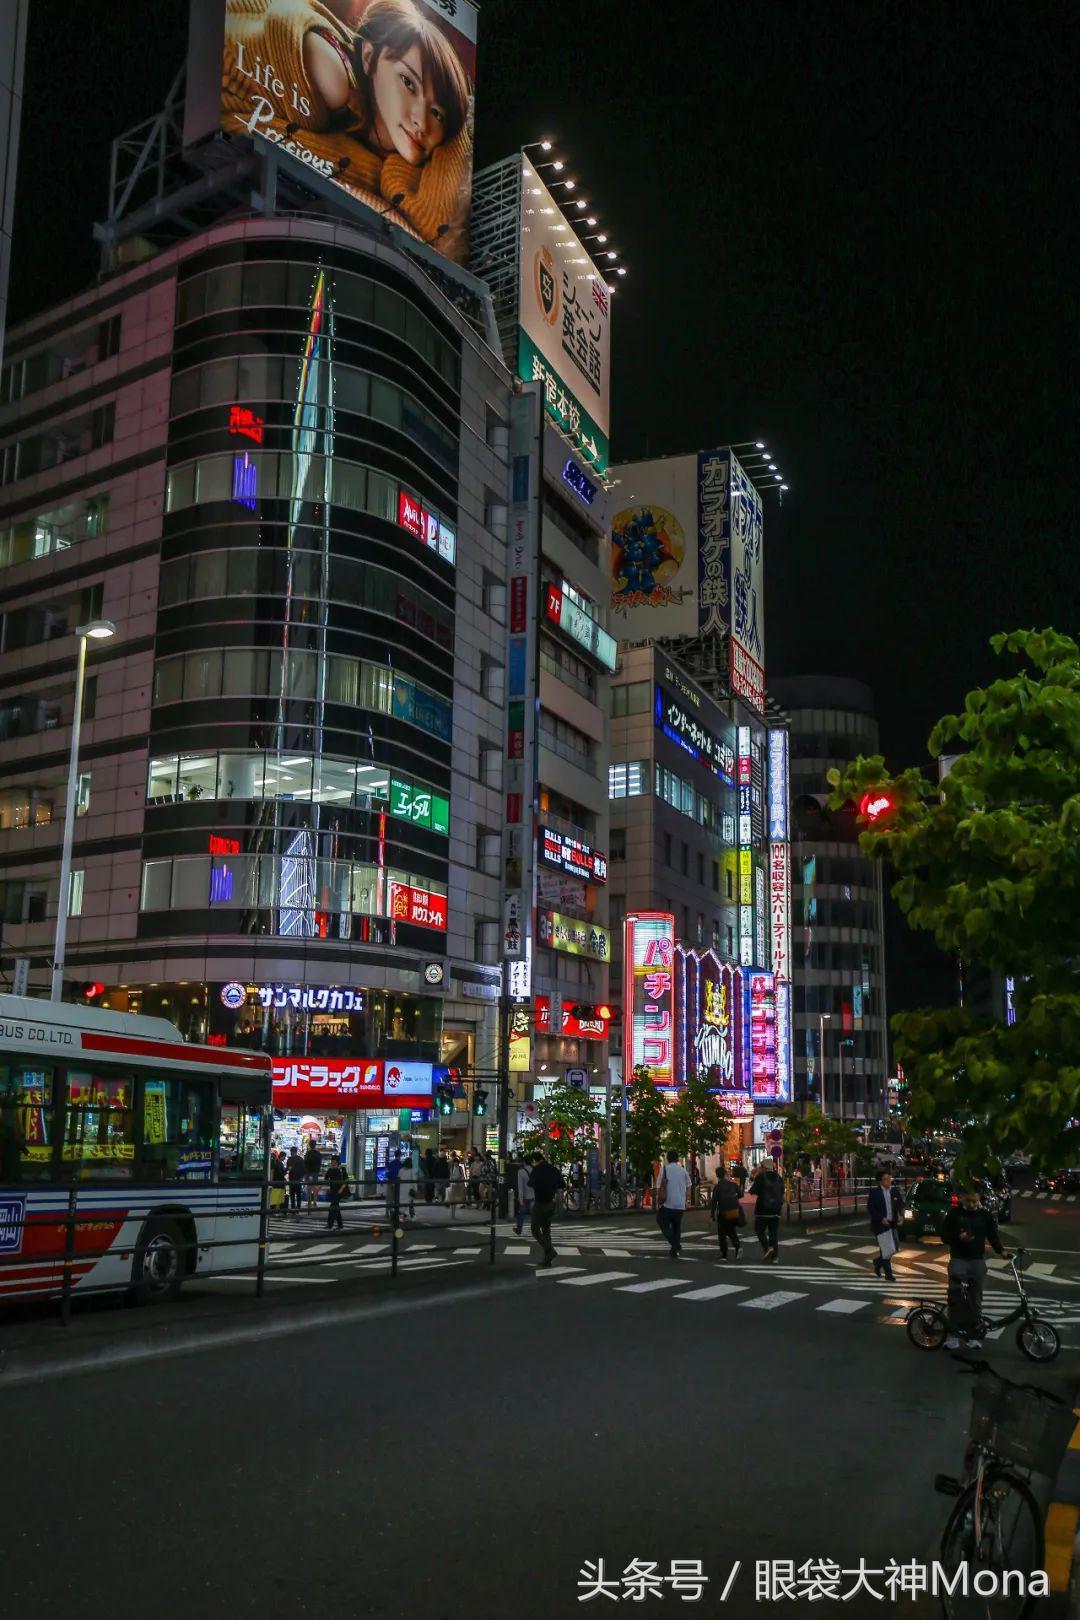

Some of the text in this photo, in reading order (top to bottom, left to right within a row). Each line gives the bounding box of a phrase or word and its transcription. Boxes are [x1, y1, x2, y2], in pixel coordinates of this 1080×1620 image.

[235, 41, 312, 117] Life is
[699, 456, 730, 634] カラオケの鉄人
[549, 594, 560, 614] 7F
[544, 829, 562, 844] BULLS
[544, 849, 562, 864] BULLS
[571, 849, 593, 868] BULLS
[770, 844, 787, 980] 100名収容大パーティールーム
[258, 987, 364, 1011] サンマルクカフェ
[642, 936, 673, 1066] パチンコ
